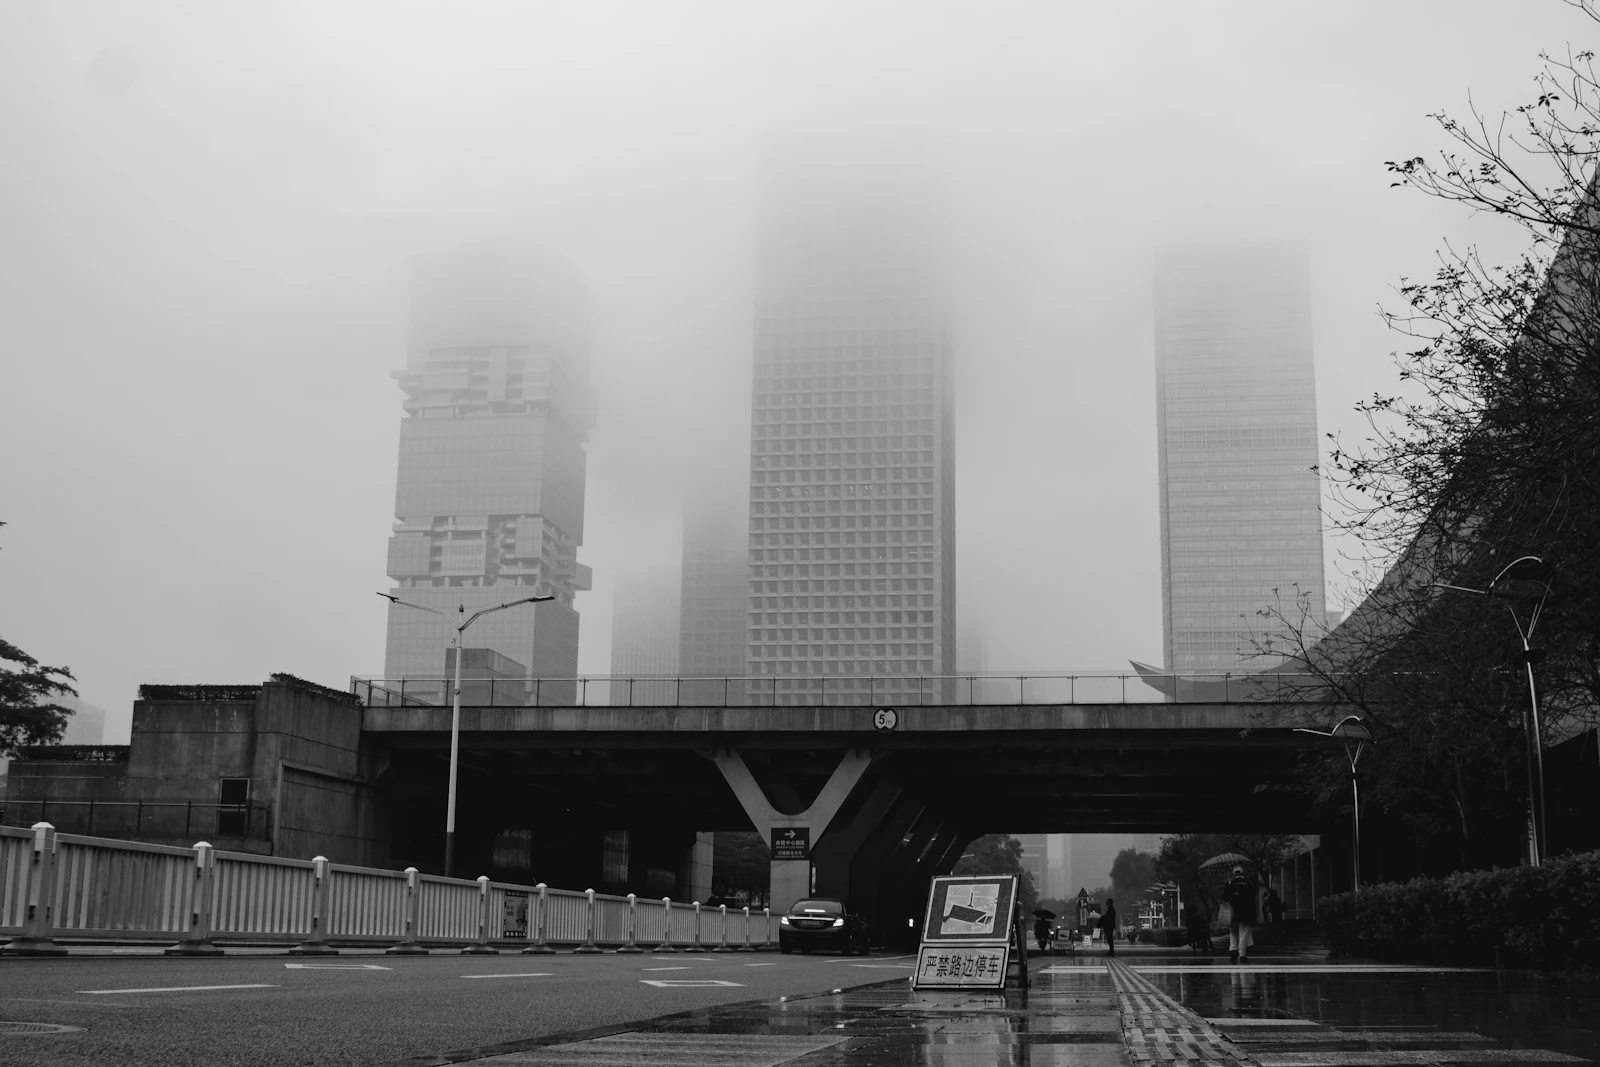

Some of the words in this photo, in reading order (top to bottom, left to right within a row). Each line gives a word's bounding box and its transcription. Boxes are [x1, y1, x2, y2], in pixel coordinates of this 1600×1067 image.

[923, 954, 1000, 977] 严禁路边停车
